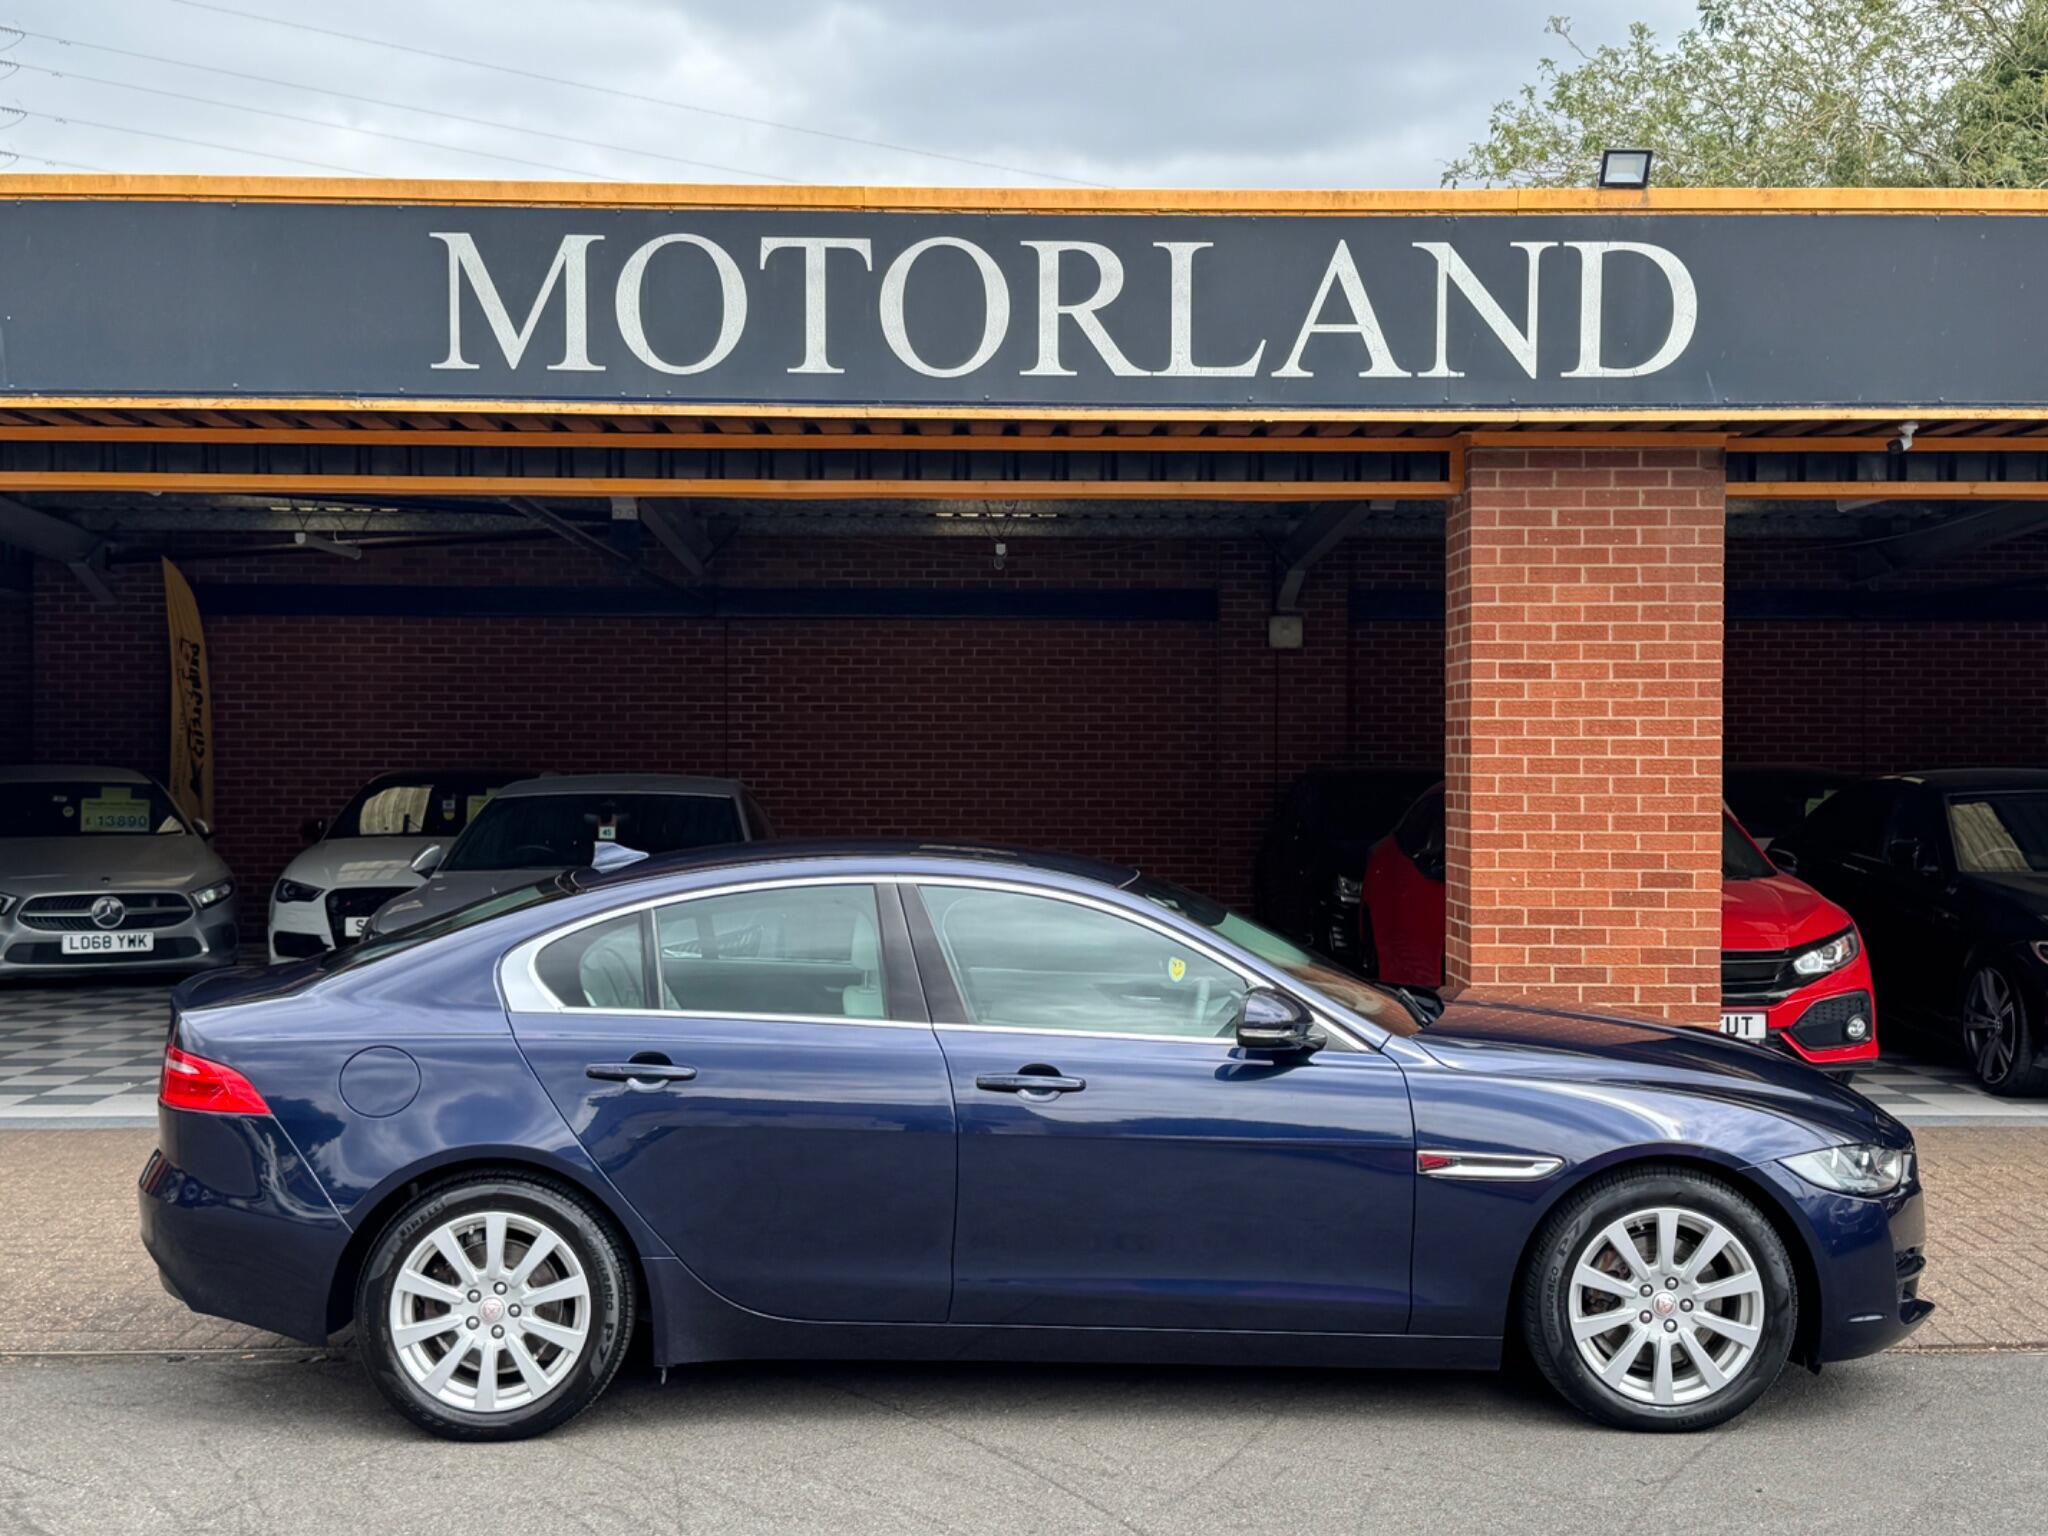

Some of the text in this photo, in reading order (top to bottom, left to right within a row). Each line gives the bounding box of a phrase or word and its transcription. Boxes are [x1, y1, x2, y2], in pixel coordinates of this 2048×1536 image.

[429, 232, 1698, 380] MOTORLAND
[117, 934, 148, 949] YWK
[1720, 1016, 1753, 1036] UT
